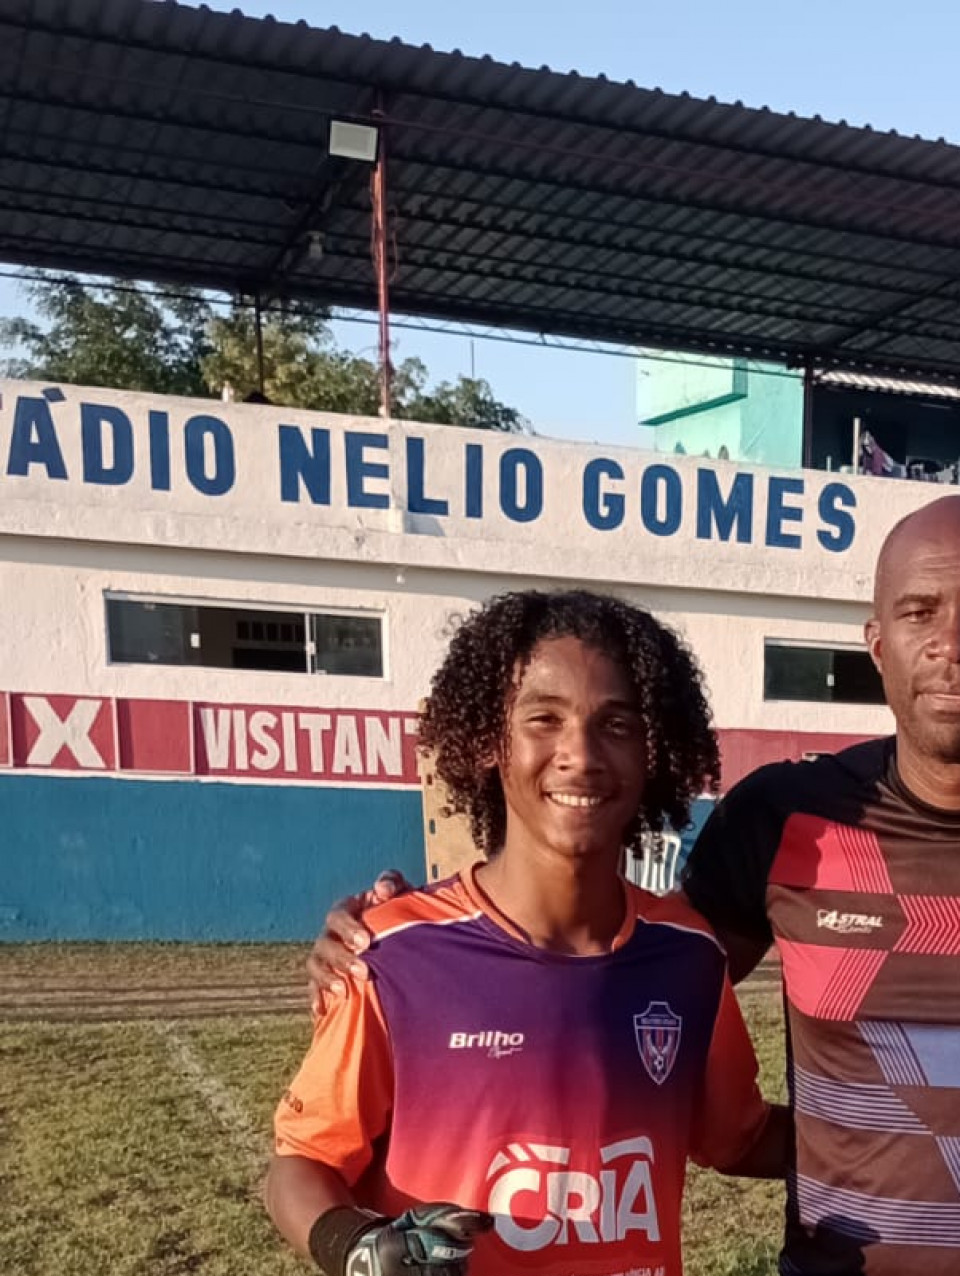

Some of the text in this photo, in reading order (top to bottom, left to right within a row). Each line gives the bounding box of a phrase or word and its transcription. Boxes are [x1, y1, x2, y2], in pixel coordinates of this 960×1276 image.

[0, 387, 857, 552] ÁDIO NELIO GOMES
[22, 697, 107, 768] X
[487, 1137, 661, 1251] CRIA
